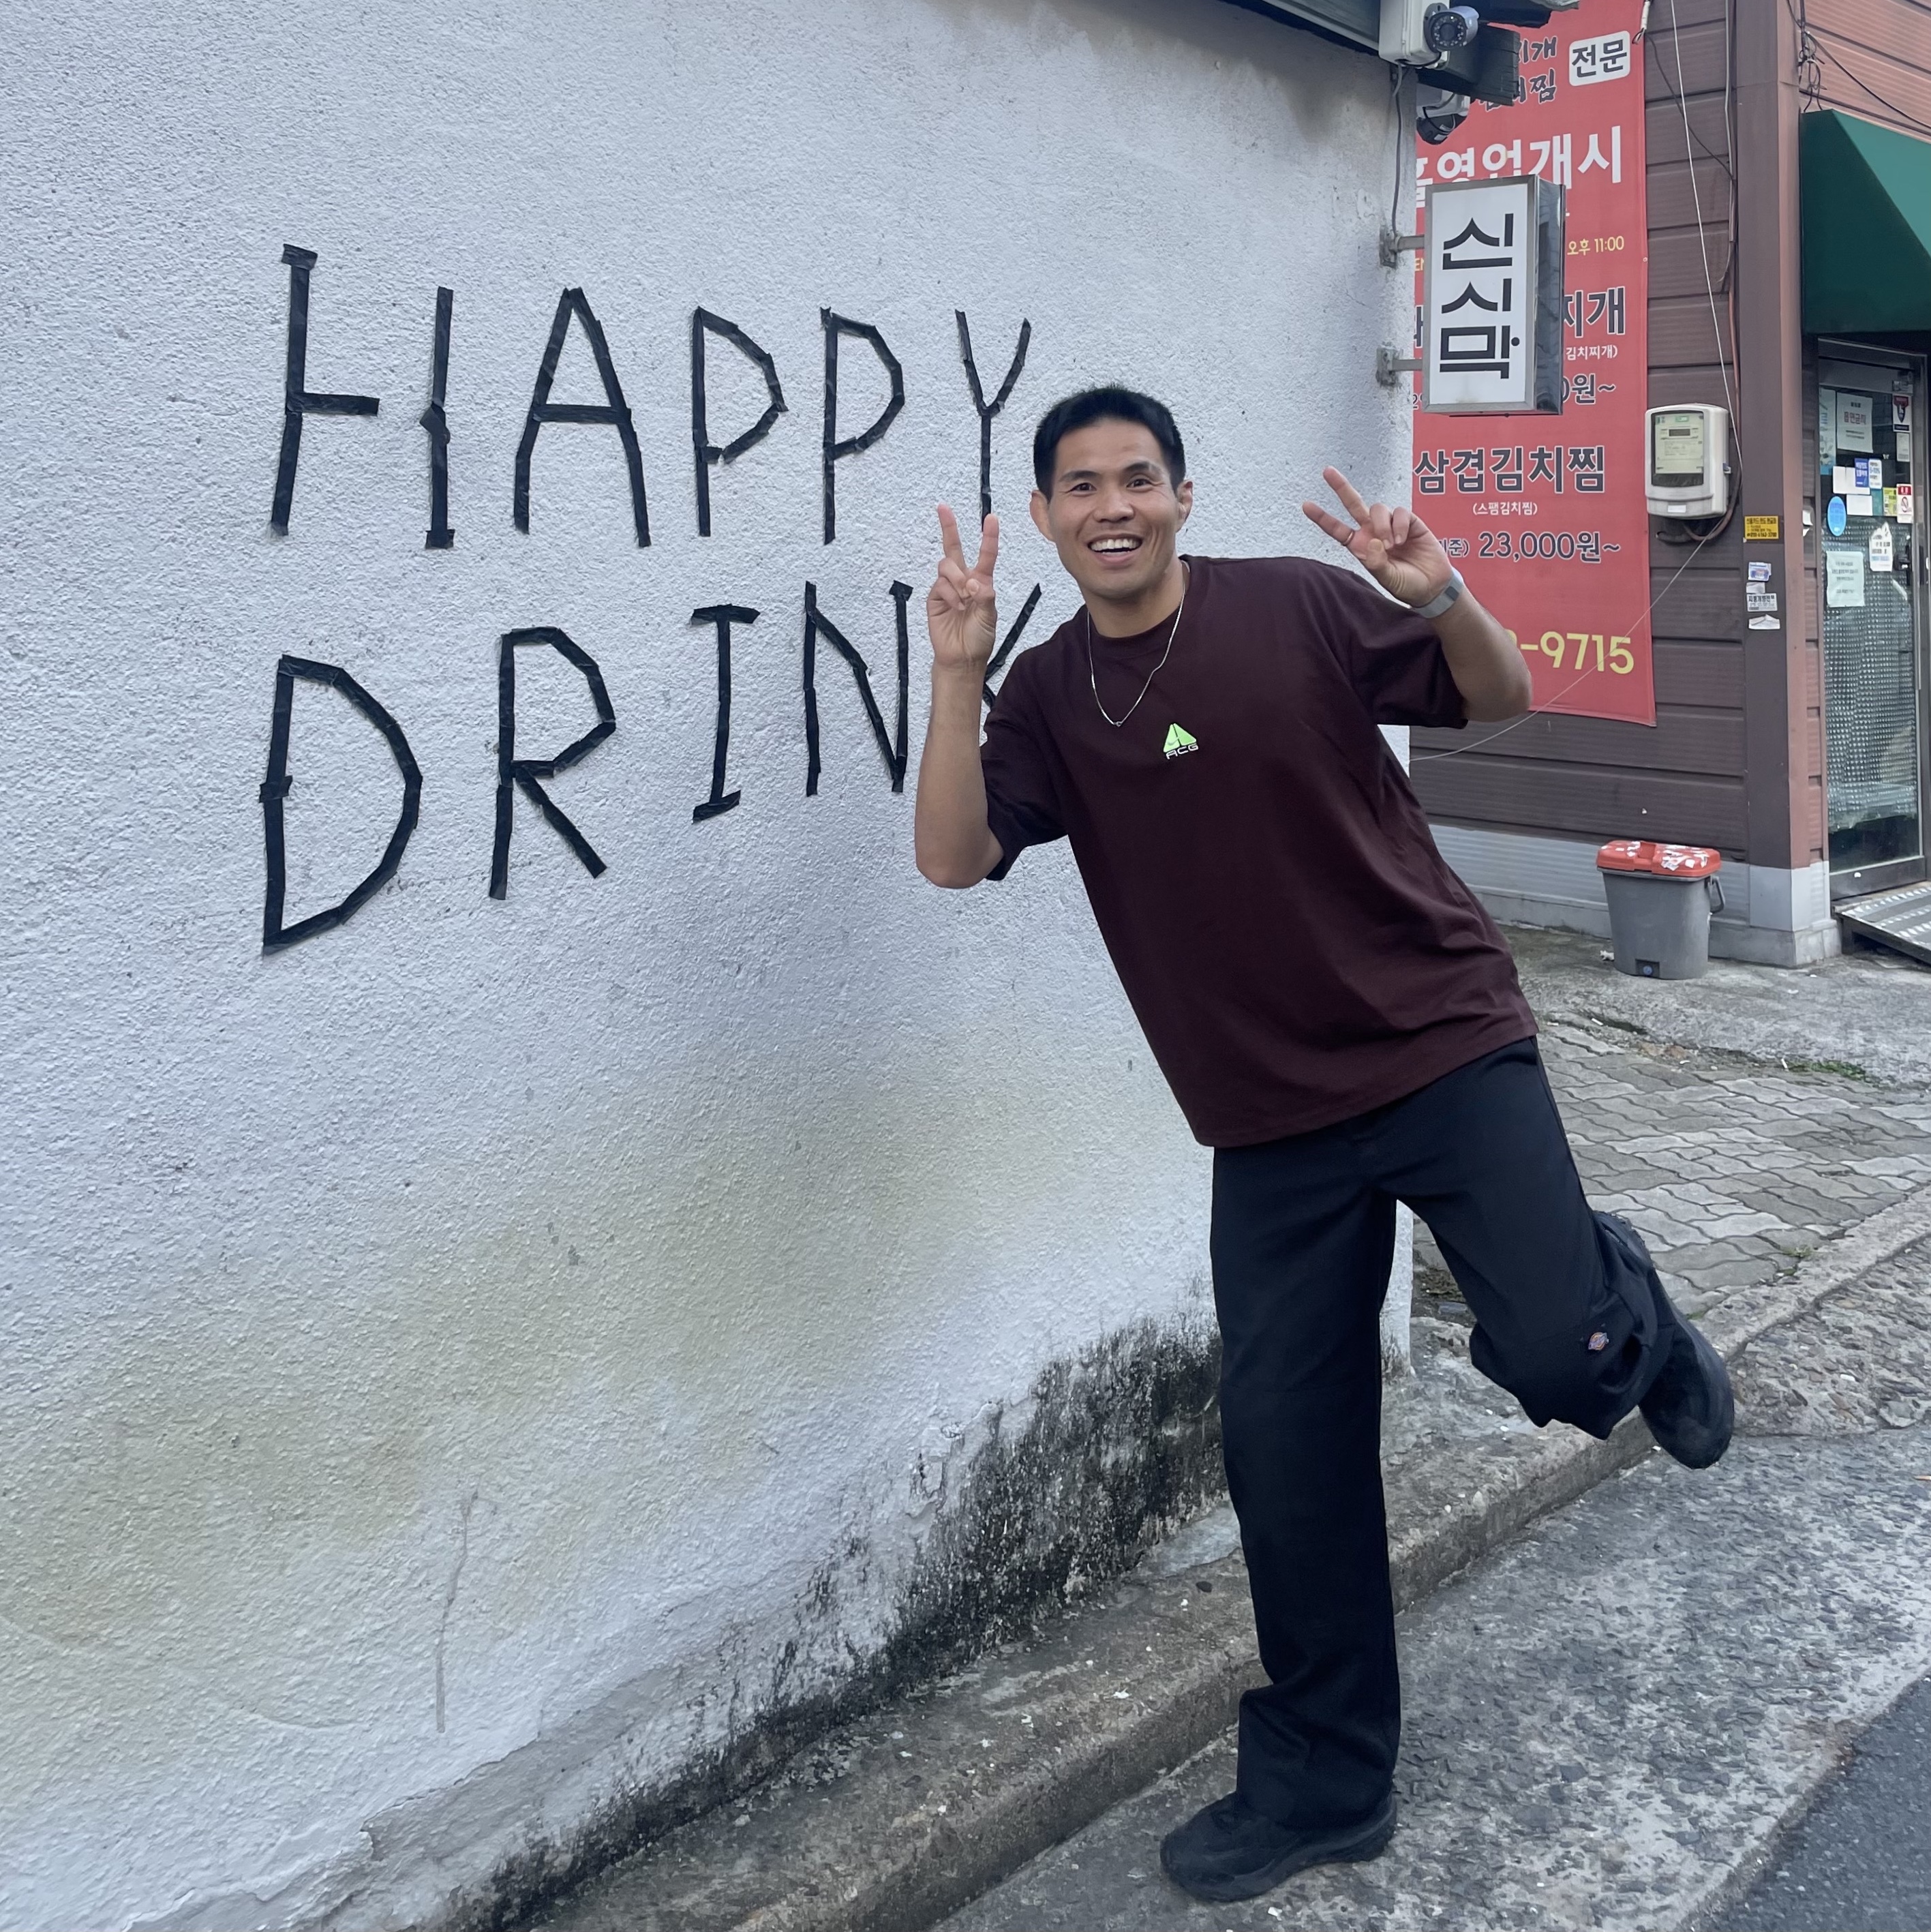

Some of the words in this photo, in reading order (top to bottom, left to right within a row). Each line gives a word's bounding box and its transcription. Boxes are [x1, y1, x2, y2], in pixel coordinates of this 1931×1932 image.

[1572, 39, 1628, 78] 전문
[1567, 240, 1590, 256] 오후
[1594, 235, 1624, 253] 11:00
[1566, 345, 1617, 360] 김치찌개)
[271, 243, 1031, 549] HAPPY
[1413, 445, 1605, 495] 삼겹김치찜
[1472, 501, 1538, 515] (스팸김치찜)
[1478, 531, 1620, 563] 23,000원~
[1166, 743, 1199, 759] ACG
